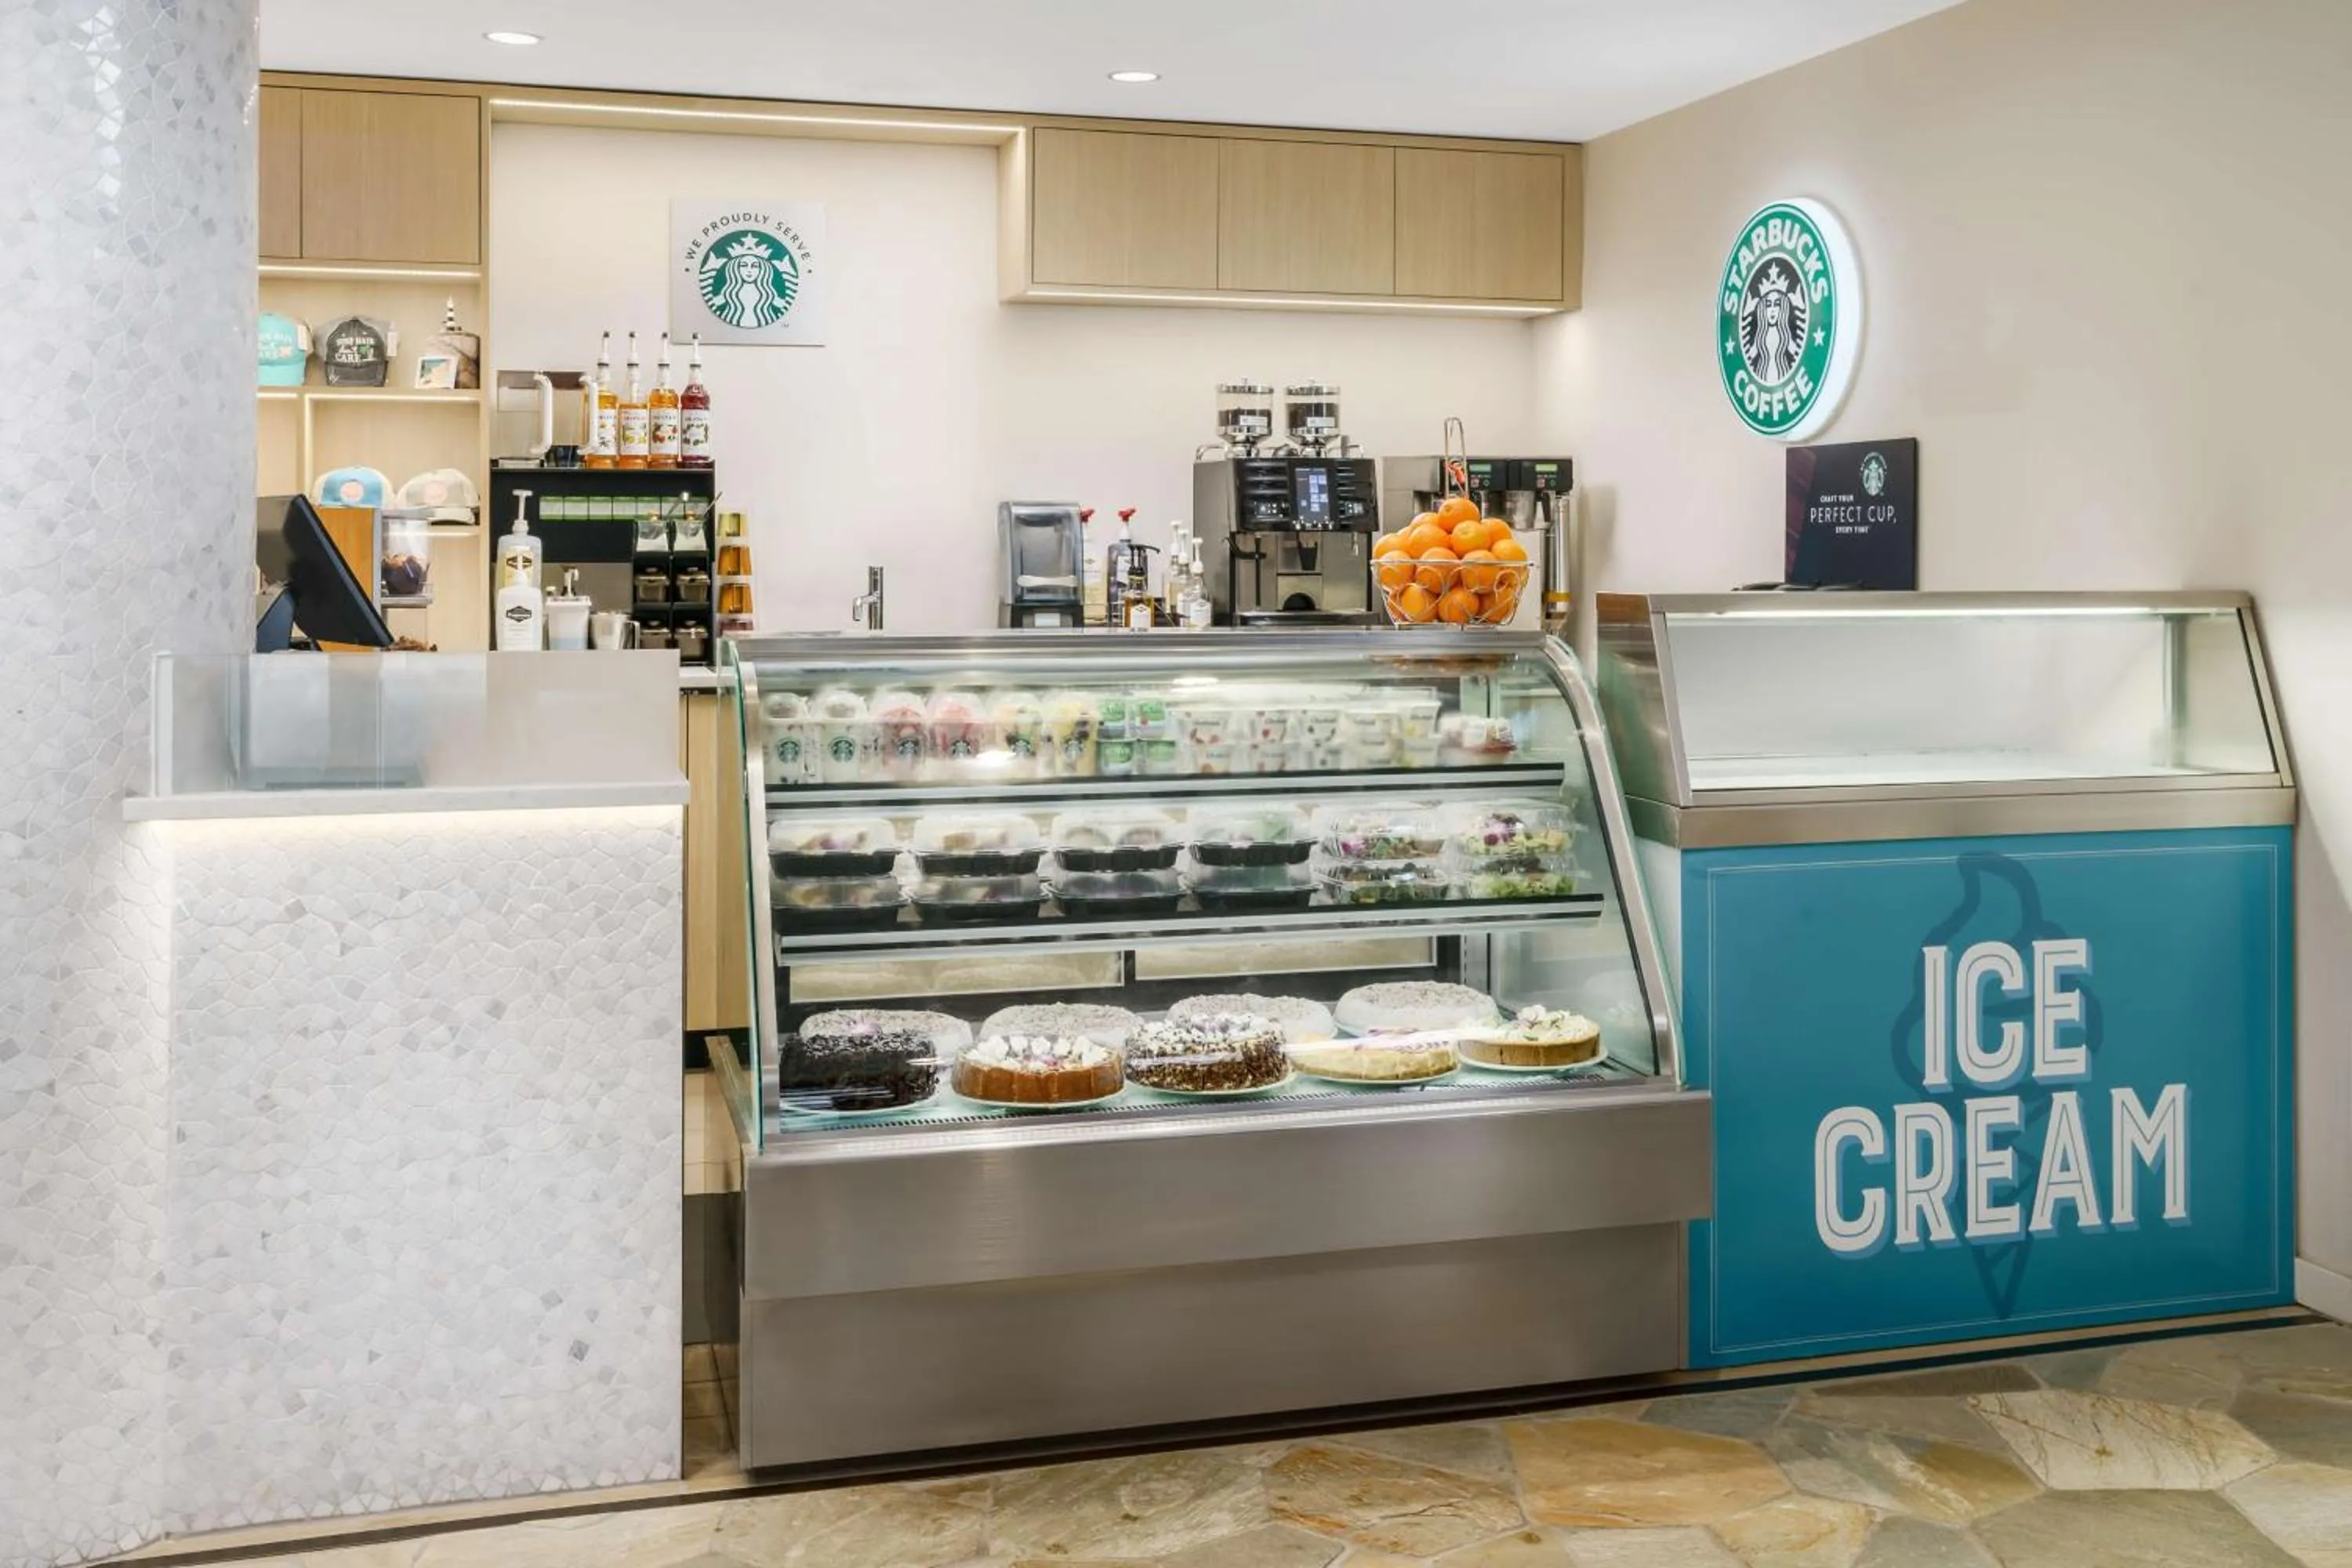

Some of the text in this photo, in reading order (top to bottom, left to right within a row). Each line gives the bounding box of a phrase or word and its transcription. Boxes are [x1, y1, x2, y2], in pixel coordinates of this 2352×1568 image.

[685, 212, 811, 260] WE PROUDLY SERVE
[1723, 218, 1828, 314] STARBUCKS
[1733, 366, 1813, 421] COFFEE
[1810, 504, 1896, 524] PERFECT CUP,
[1922, 938, 2090, 1091] ICE
[1814, 1083, 2190, 1258] CREAM
